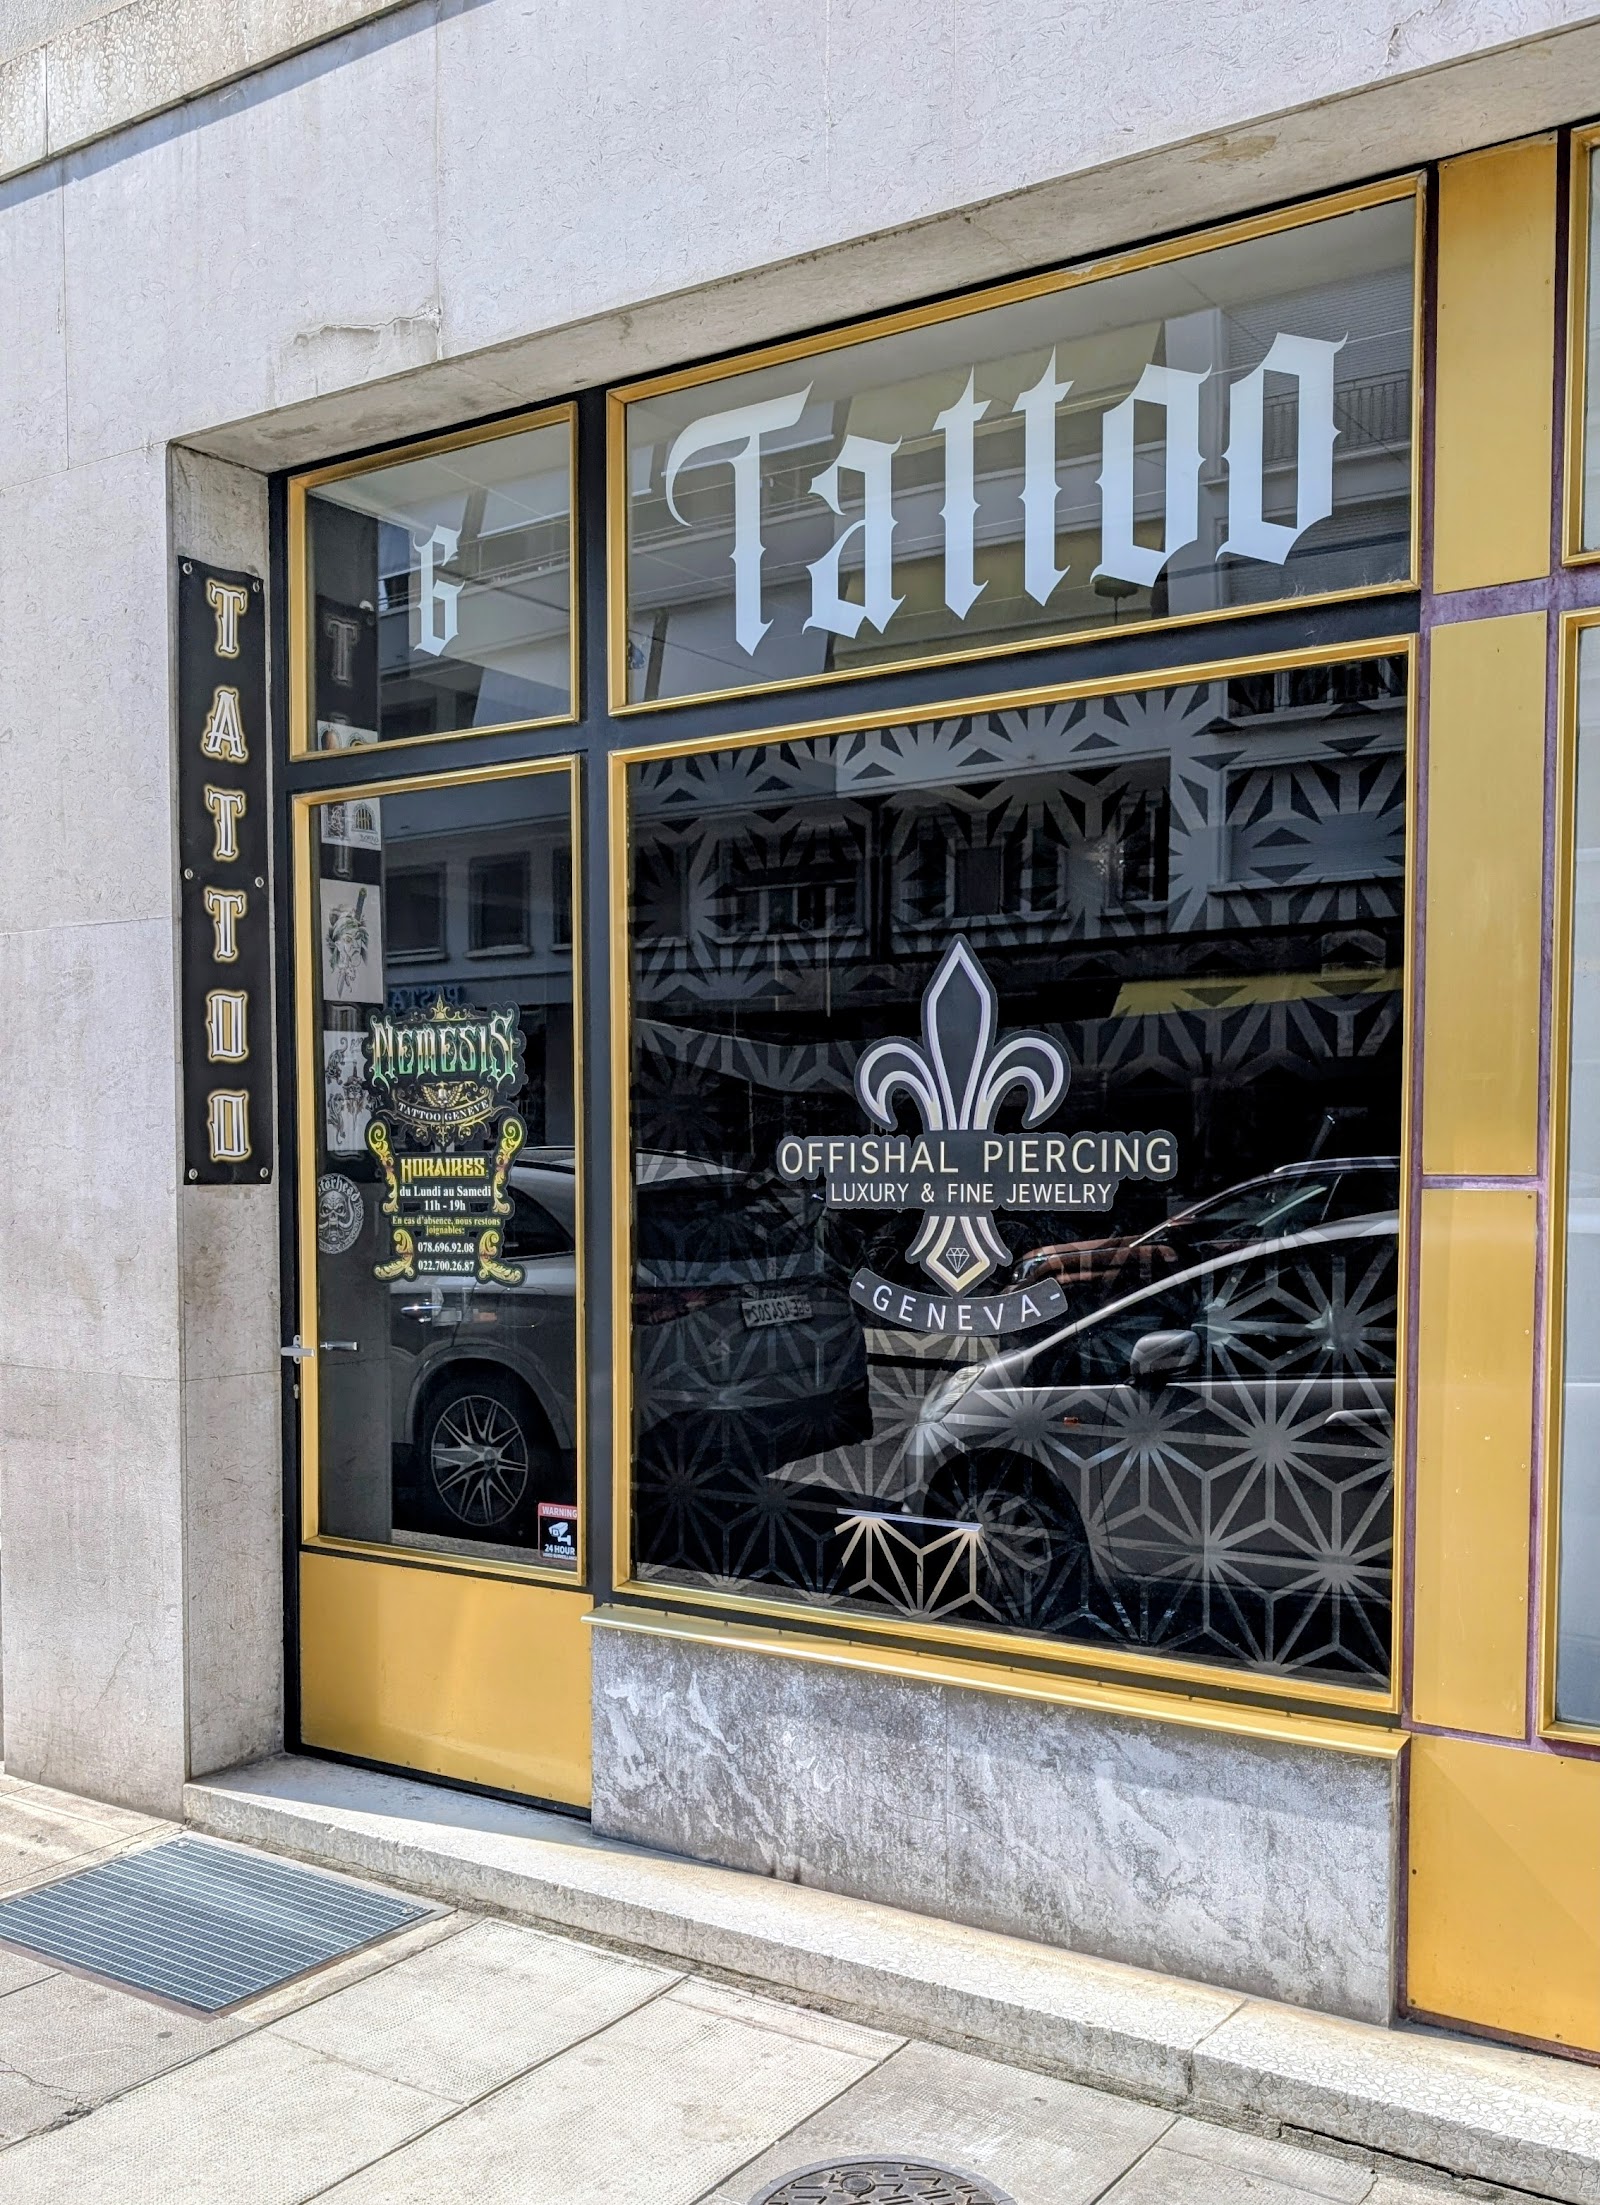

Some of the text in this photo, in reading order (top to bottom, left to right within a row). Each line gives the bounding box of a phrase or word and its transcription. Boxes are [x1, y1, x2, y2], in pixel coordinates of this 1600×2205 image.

[664, 332, 1349, 656] Tattoo
[202, 584, 249, 1160] TATTOO
[369, 1008, 521, 1093] NEMESIS
[398, 1102, 441, 1121] TATTOO
[781, 1137, 1172, 1175] OFFISHAL PIERCING
[400, 1186, 491, 1197] du Lundi au Samedi
[831, 1183, 1112, 1204] LUXURY & FINE JEWELRY
[425, 1200, 440, 1211] 11h
[450, 1200, 466, 1211] 19h
[392, 1216, 402, 1225] En
[455, 1217, 472, 1225] nous
[474, 1217, 500, 1226] restons
[417, 1242, 474, 1253] 078.696.92.08
[418, 1261, 474, 1271] 022.700.26.87
[542, 1506, 577, 1518] WARNING
[544, 1544, 554, 1553] 24
[554, 1545, 575, 1556] HOUR
